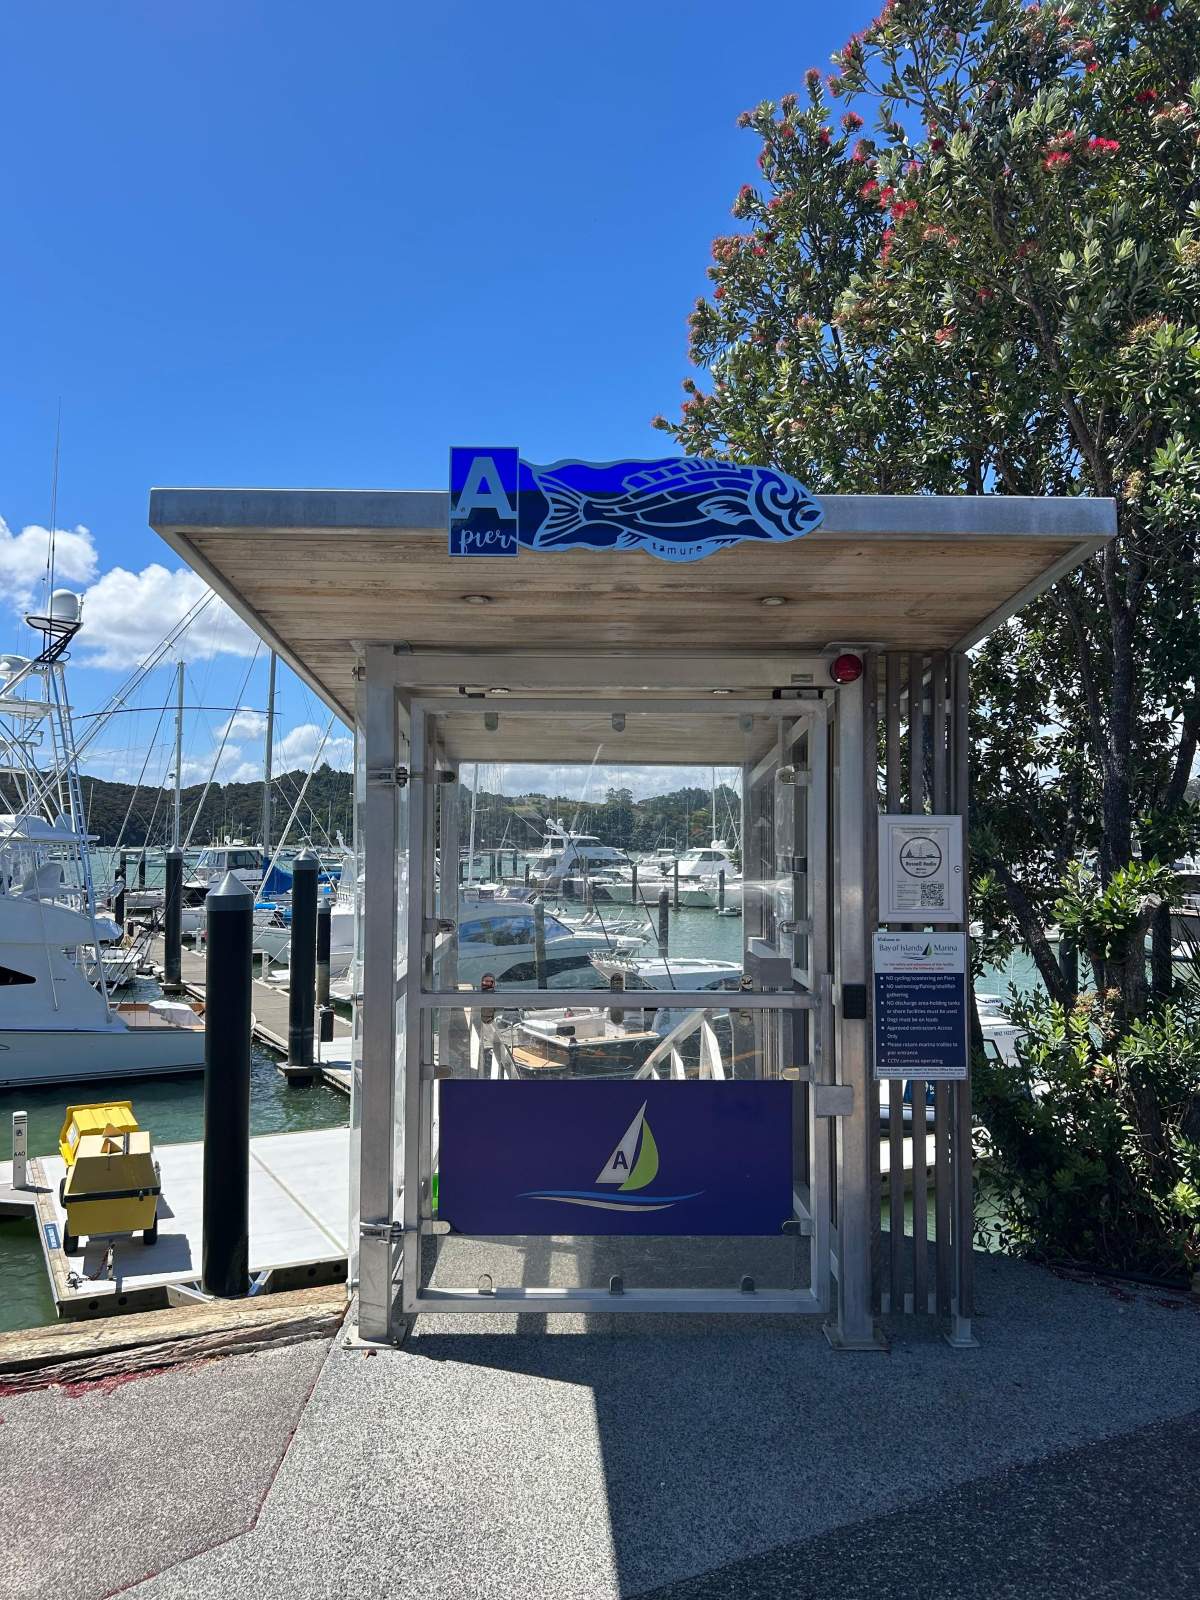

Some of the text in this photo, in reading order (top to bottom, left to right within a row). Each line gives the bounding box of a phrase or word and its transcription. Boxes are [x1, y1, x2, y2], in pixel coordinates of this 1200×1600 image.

[452, 456, 517, 519] A
[459, 529, 513, 554] pier
[652, 542, 703, 556] tamure
[879, 944, 958, 953] Bay of Islands Marina
[612, 1150, 629, 1170] A
